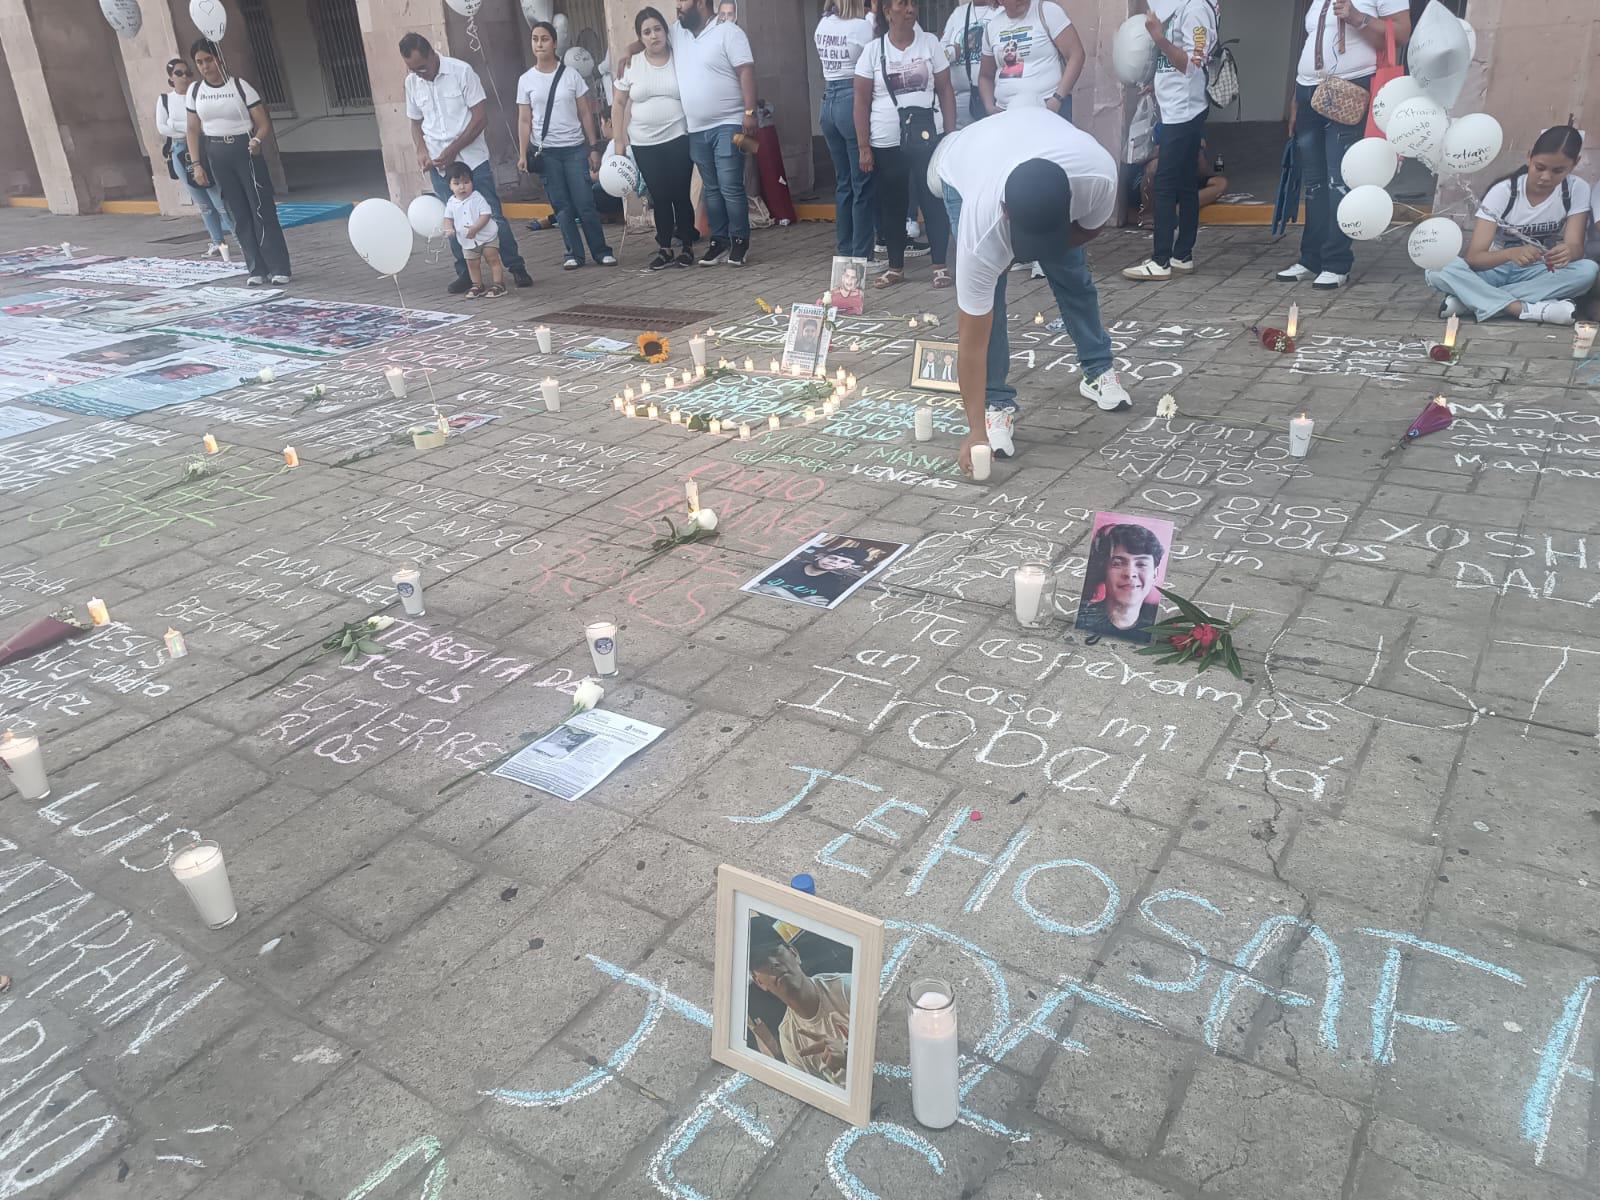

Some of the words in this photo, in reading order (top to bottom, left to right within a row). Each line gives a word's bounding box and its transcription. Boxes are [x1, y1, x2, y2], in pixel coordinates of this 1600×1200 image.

[822, 421, 901, 442] ROJO
[509, 433, 677, 468] EMANUEL
[1378, 518, 1600, 568] YOSH
